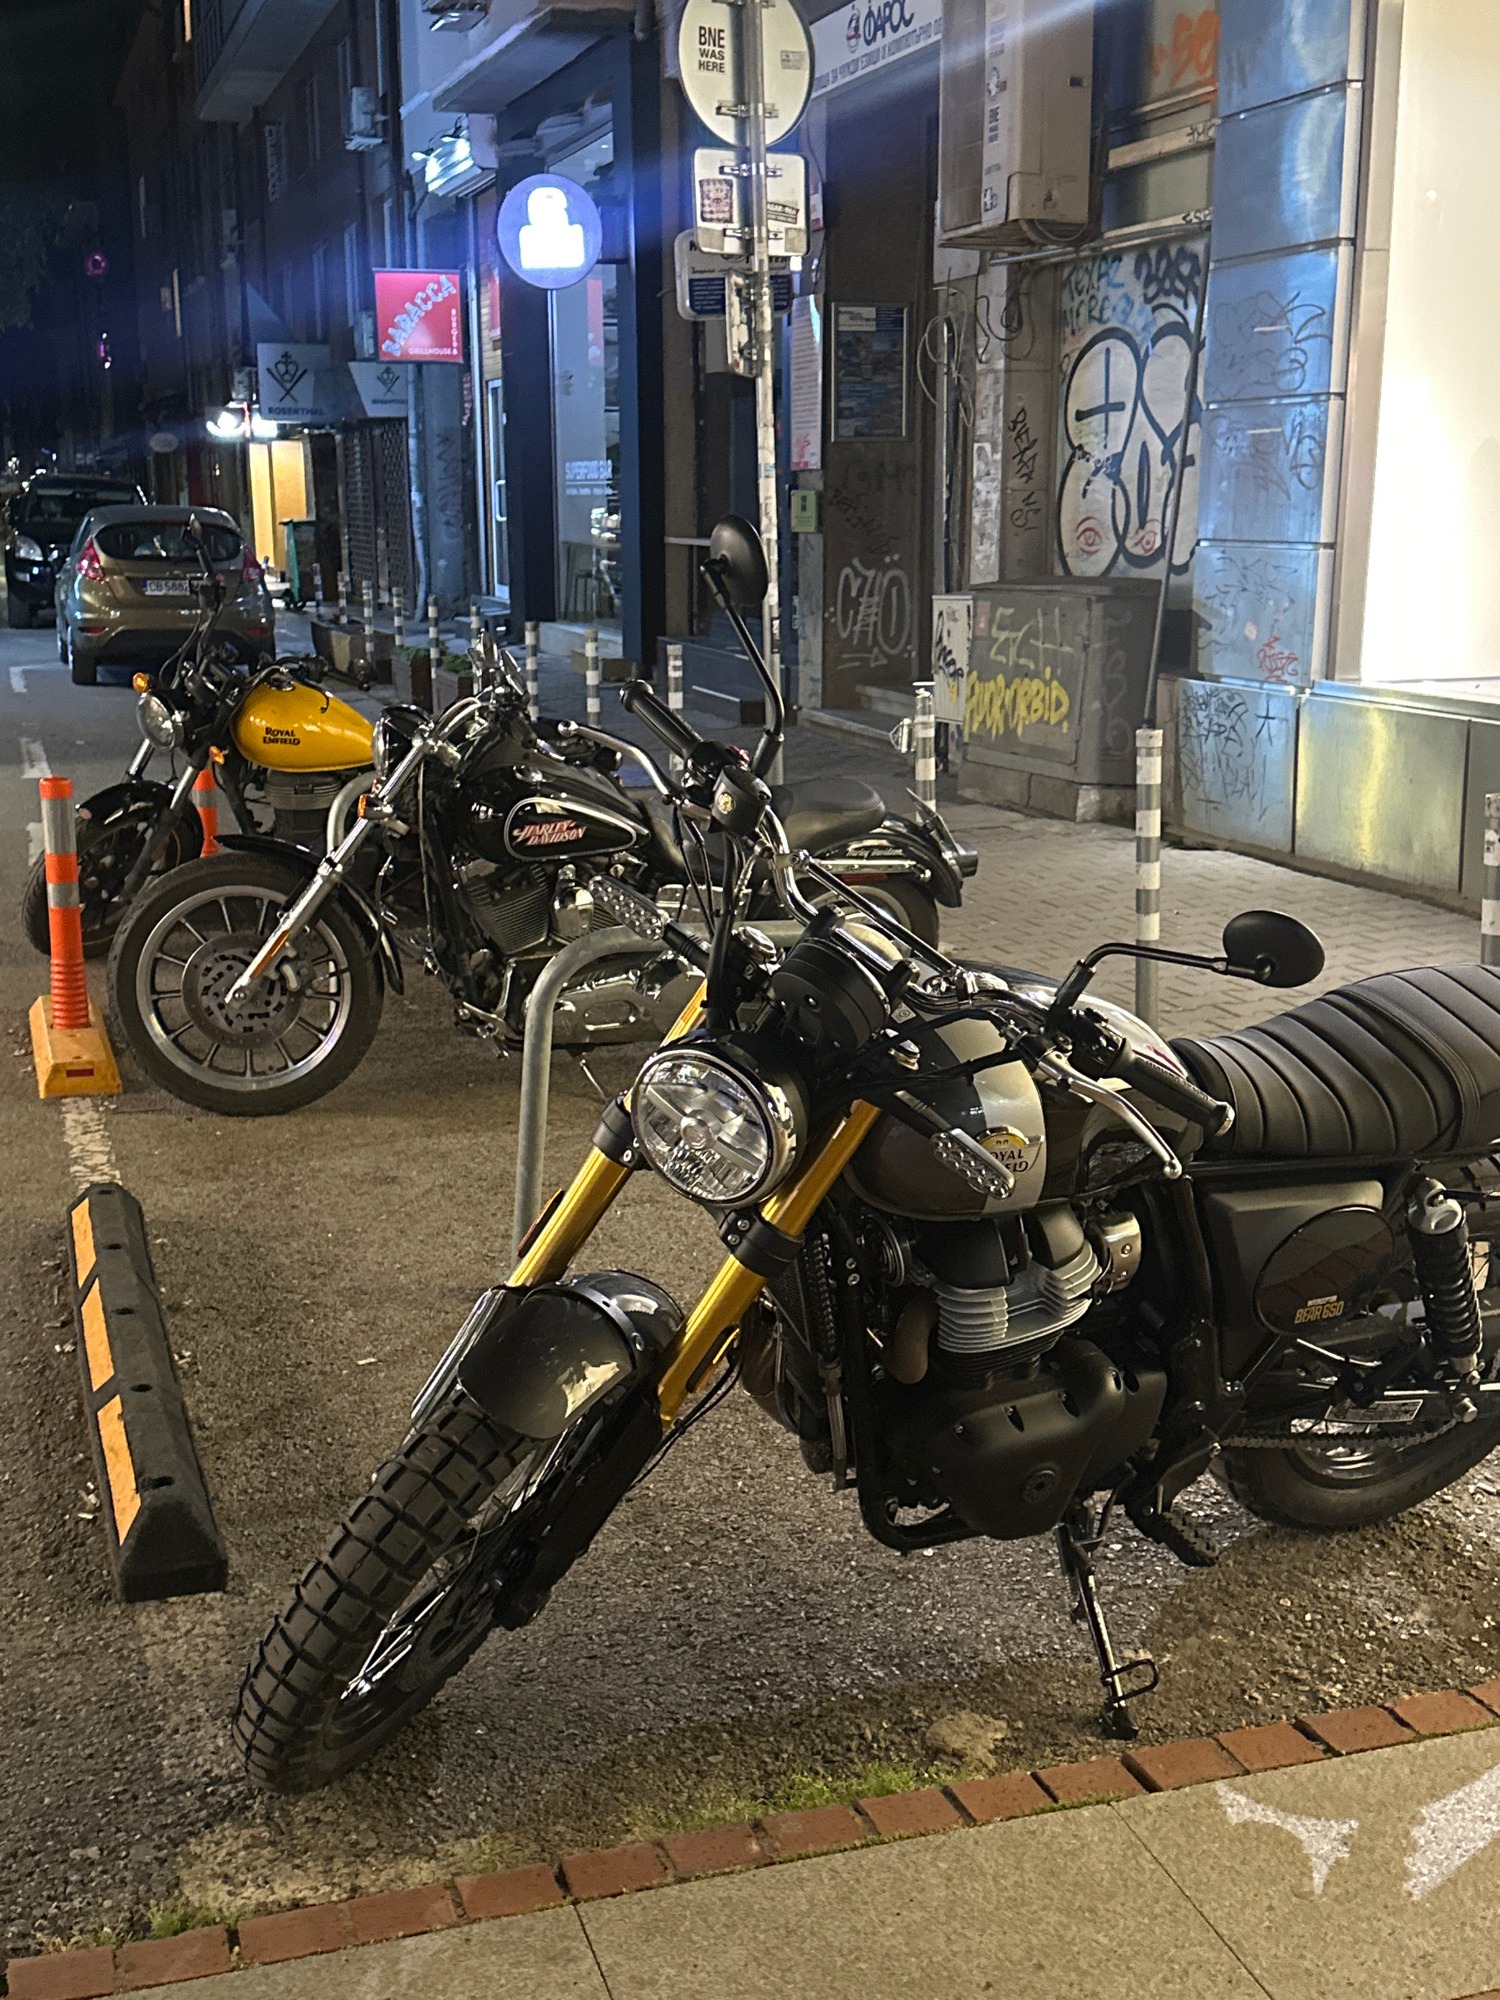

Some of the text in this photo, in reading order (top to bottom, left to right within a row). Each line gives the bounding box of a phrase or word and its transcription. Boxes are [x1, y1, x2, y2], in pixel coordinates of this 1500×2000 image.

[698, 25, 725, 48] BNE
[698, 48, 725, 61] WAS
[698, 60, 725, 73] HERE
[381, 275, 457, 357] BARACCA
[265, 727, 296, 737] ROYAL
[263, 736, 301, 746] ENFIELD
[525, 826, 586, 846] DAVIDSON
[989, 1148, 1025, 1161] OYAL
[1294, 1301, 1344, 1324] BEAR 650
